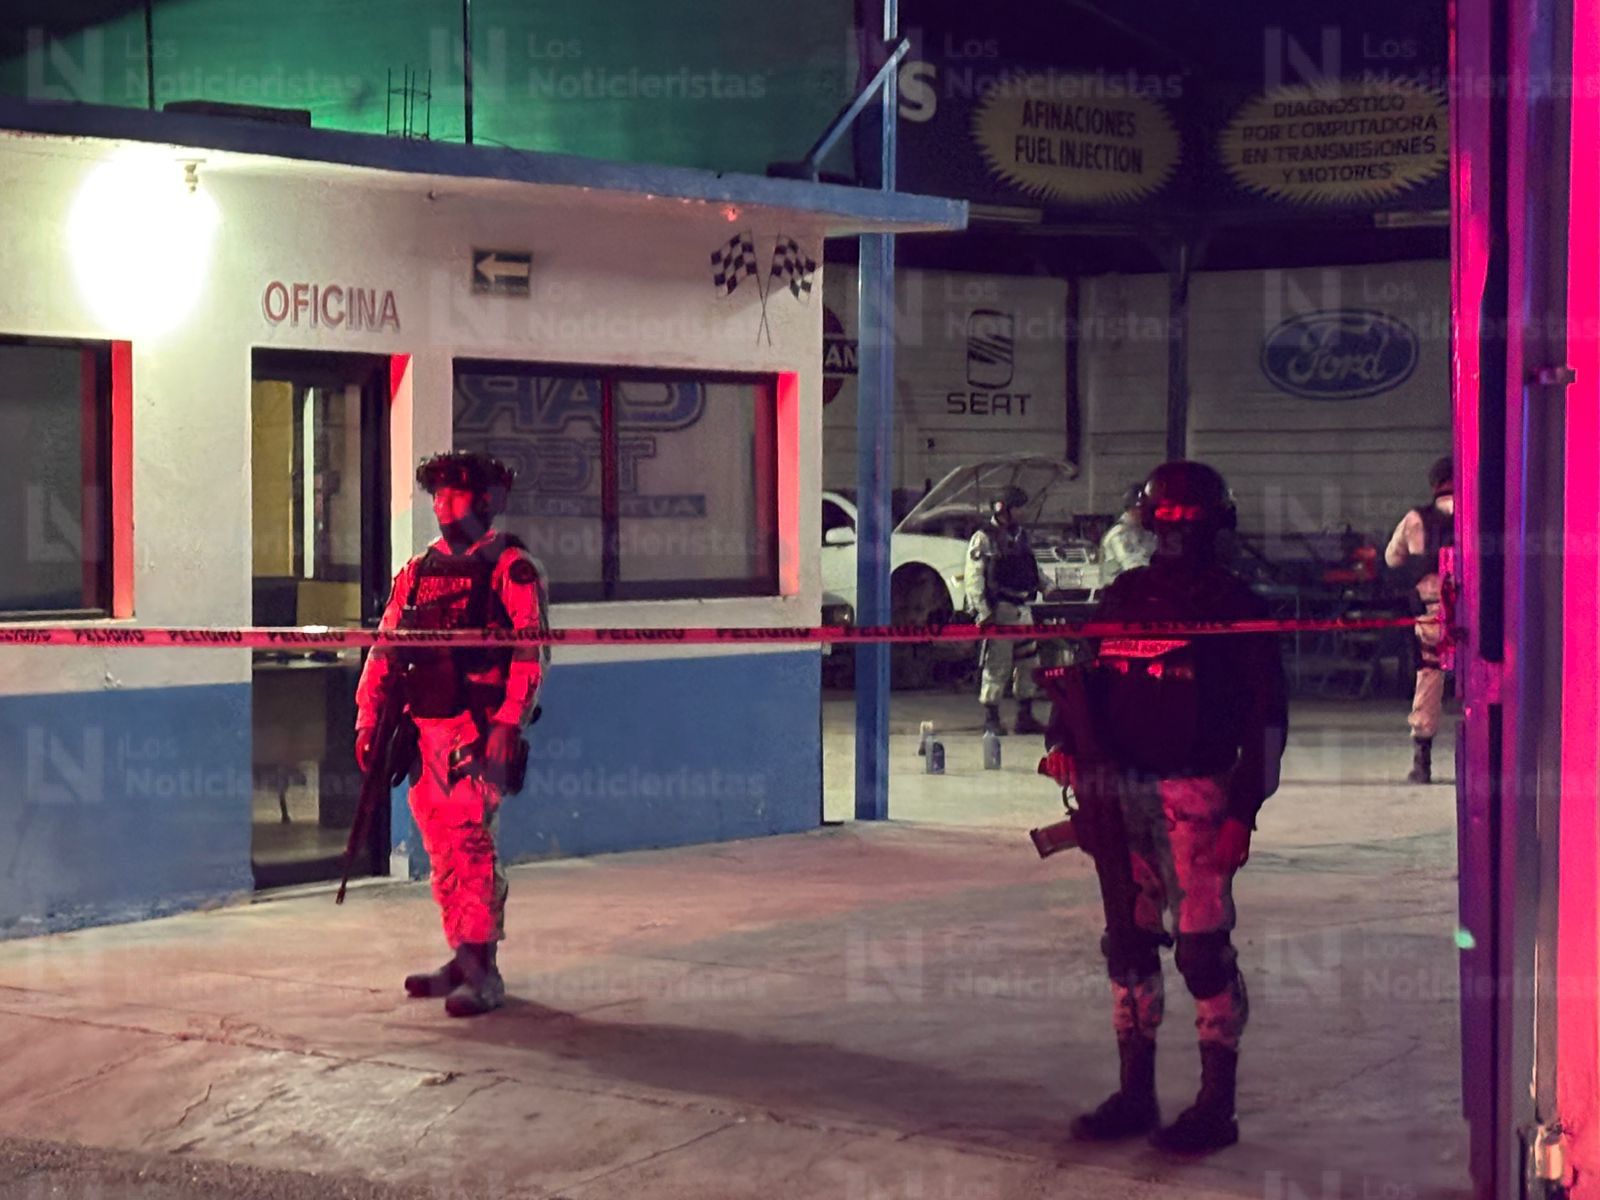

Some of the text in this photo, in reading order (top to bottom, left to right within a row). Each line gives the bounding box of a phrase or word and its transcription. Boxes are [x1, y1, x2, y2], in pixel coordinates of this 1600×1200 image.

[1022, 101, 1137, 139] AFINACIONES
[1273, 95, 1406, 118] DIAGNOSTICO
[1243, 114, 1439, 141] POR COMPUTADORA
[1015, 135, 1143, 174] FUEL INJECTION
[1242, 136, 1437, 164] EN TRANSMISIONES
[1283, 164, 1392, 184] Y MOTORES
[263, 281, 401, 332] OFICINA
[1287, 315, 1388, 382] Ford
[946, 392, 1032, 416] SEAT
[167, 630, 243, 642] PELIGRO
[595, 628, 685, 640] PELIGRO
[716, 628, 811, 639] PELIGRO
